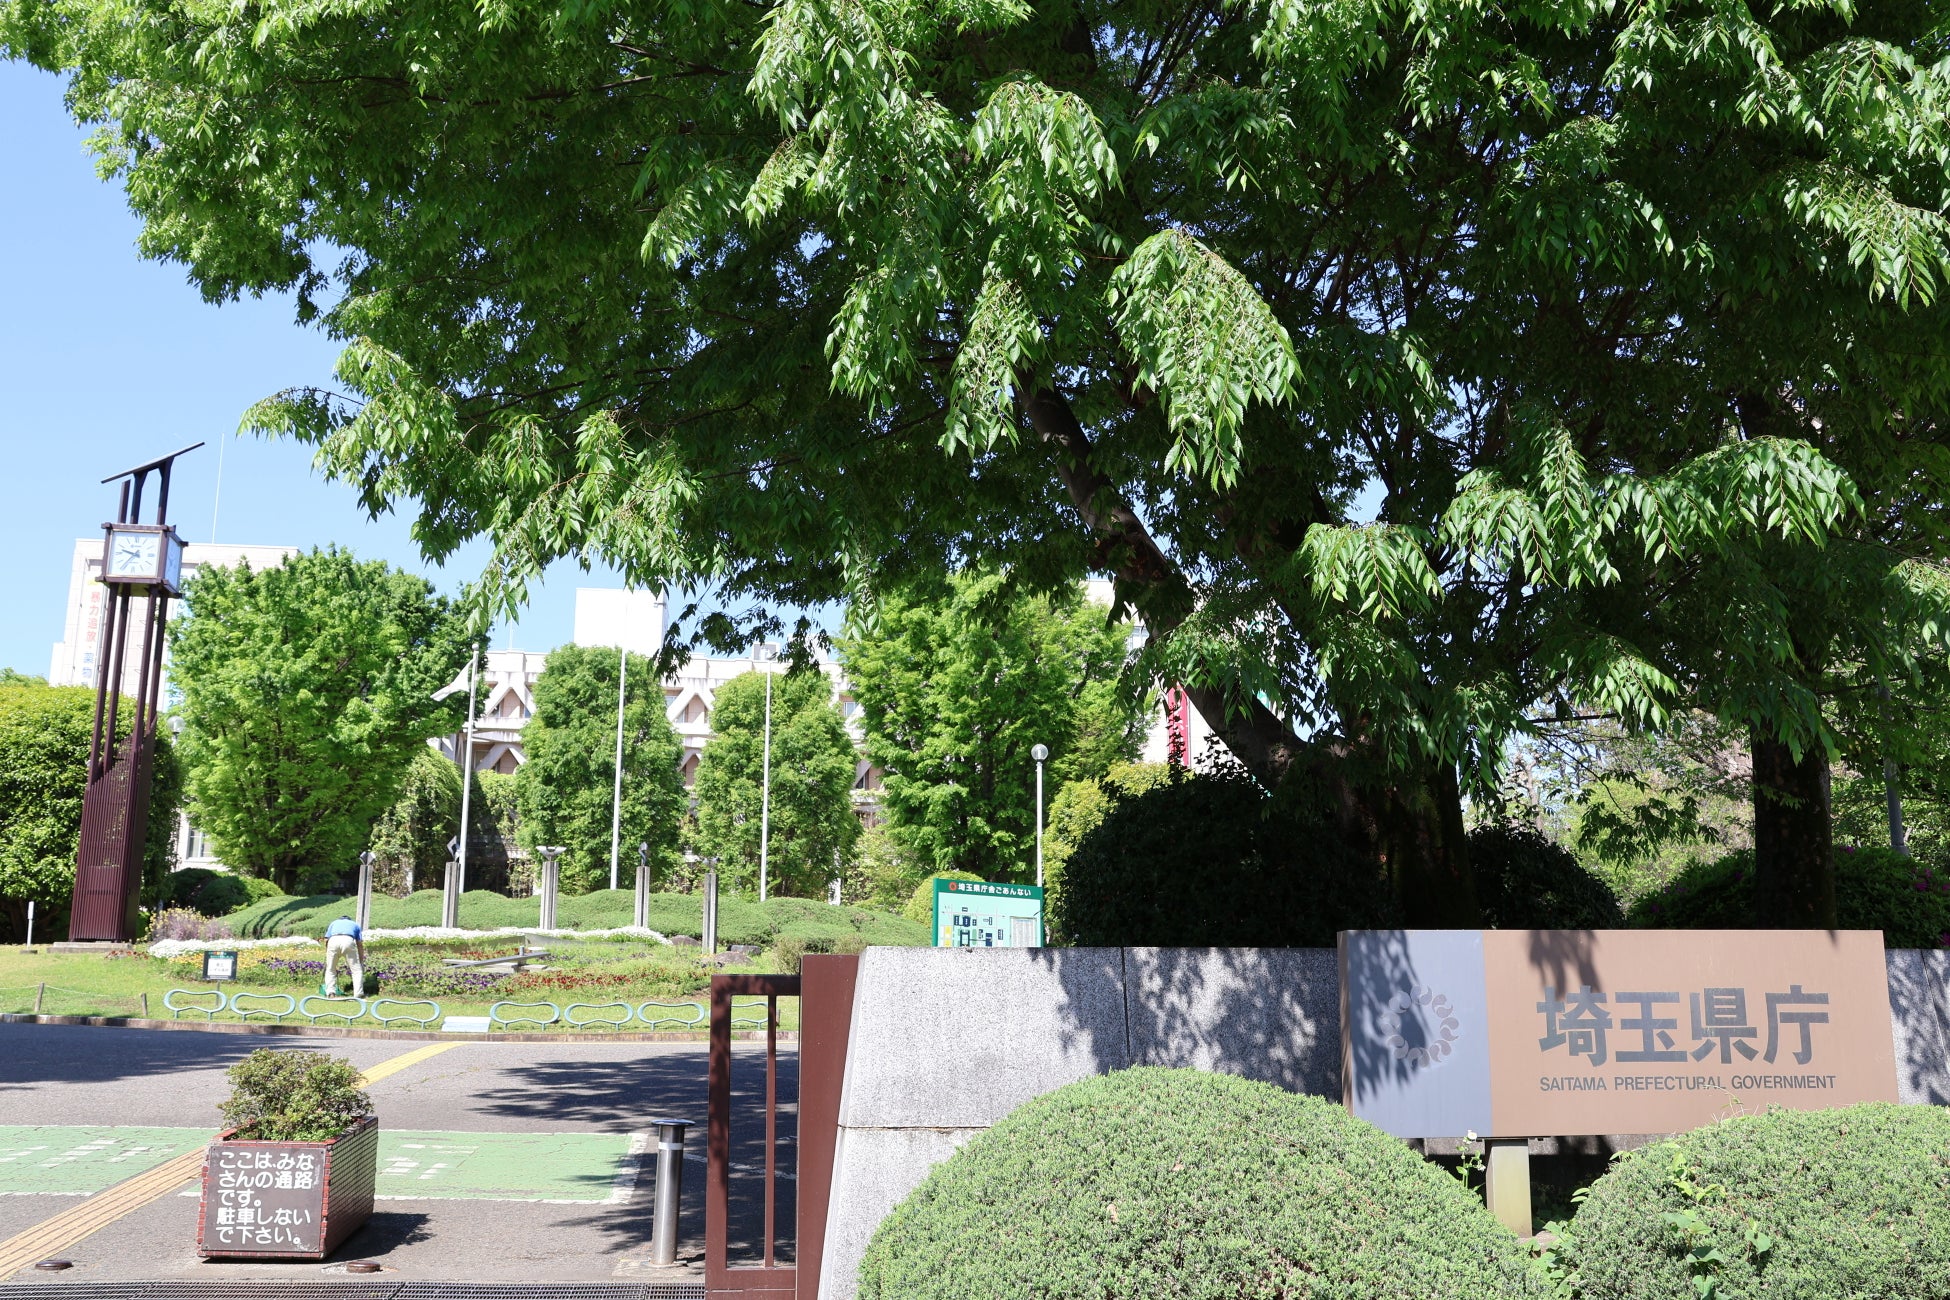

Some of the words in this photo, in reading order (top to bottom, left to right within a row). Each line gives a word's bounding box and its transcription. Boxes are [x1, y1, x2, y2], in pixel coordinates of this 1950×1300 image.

[958, 883, 1031, 896] 埼玉県庁舎ごあんない
[1536, 985, 1829, 1067] 埼玉県庁
[1540, 1077, 1607, 1091] SAITAMA
[1614, 1076, 1726, 1091] PREFECTURAL
[1731, 1075, 1836, 1089] GOVERNMENT
[219, 1170, 313, 1189] さんの通路
[217, 1189, 262, 1207] です。
[216, 1207, 311, 1225] 駐車しない
[215, 1226, 301, 1245] で下さい。
